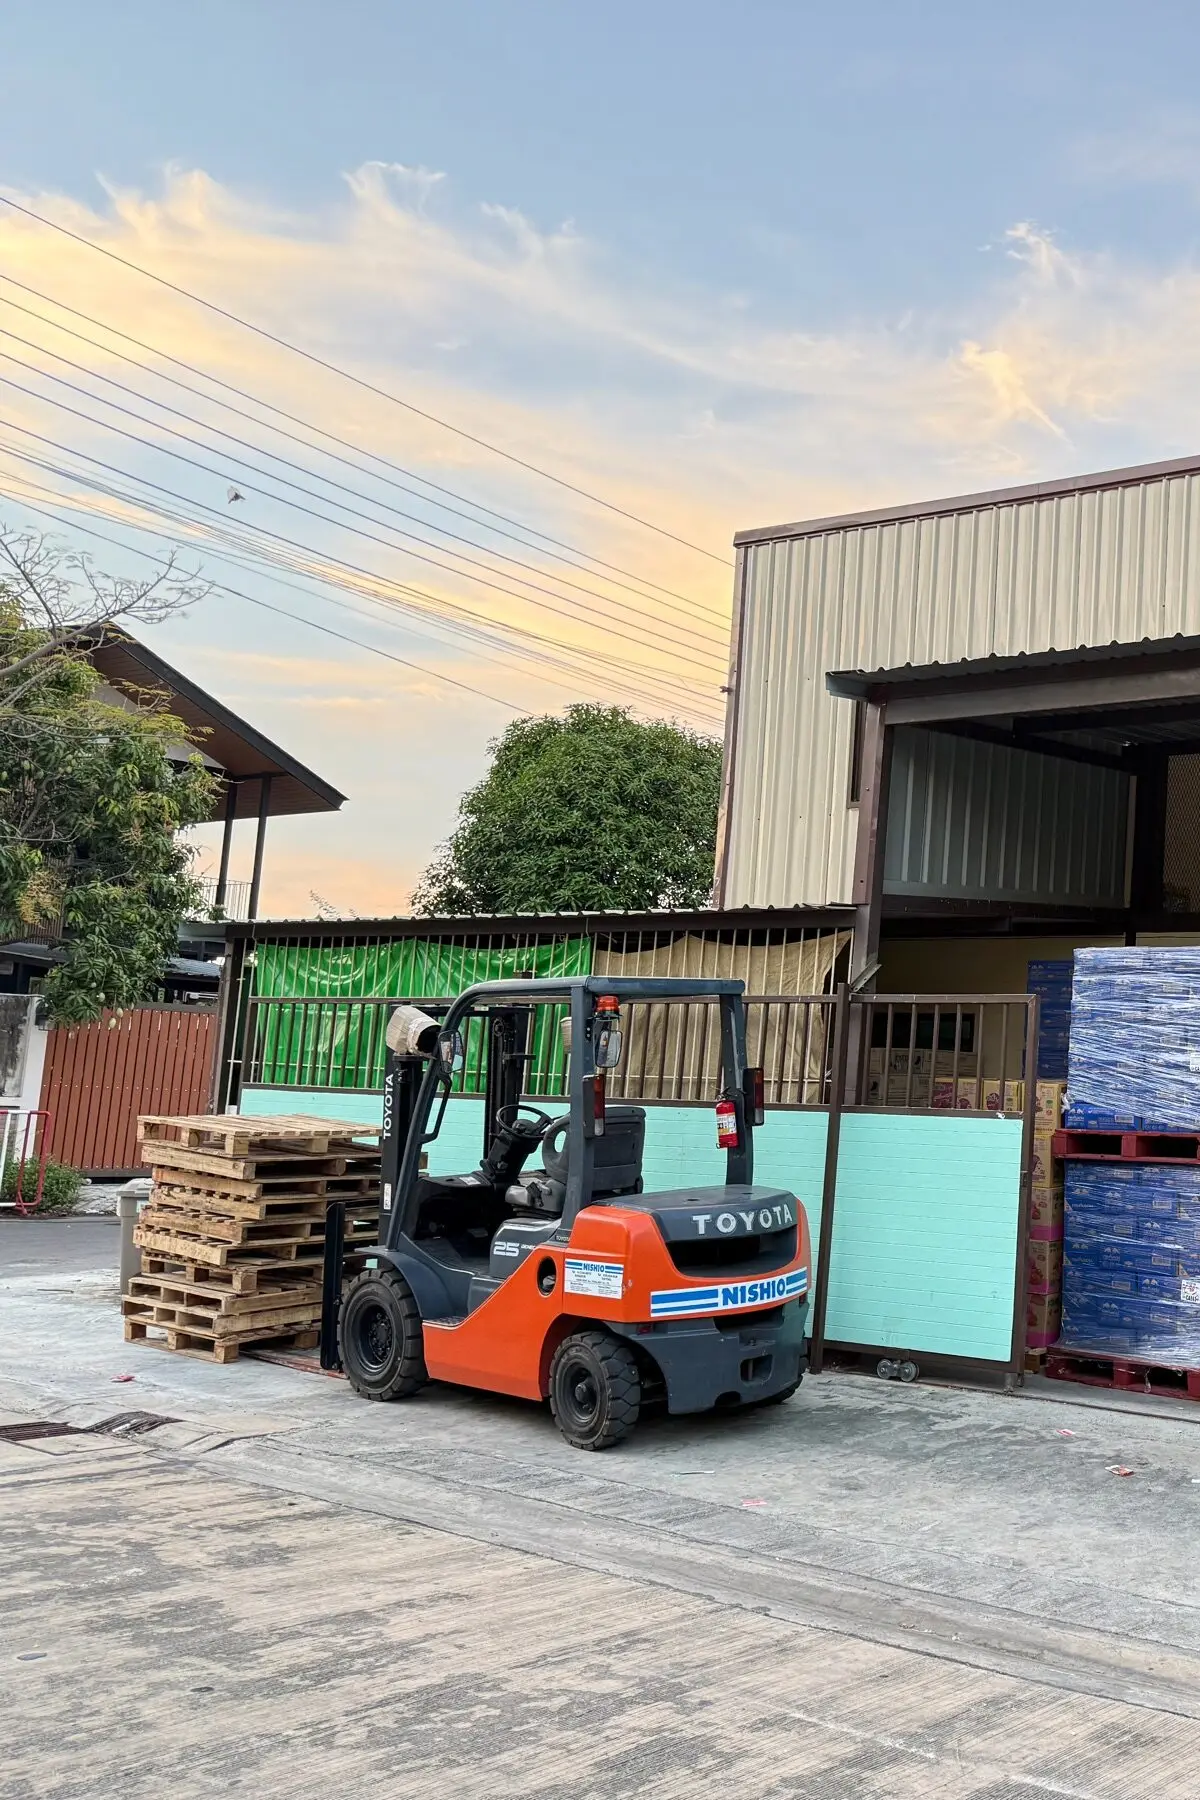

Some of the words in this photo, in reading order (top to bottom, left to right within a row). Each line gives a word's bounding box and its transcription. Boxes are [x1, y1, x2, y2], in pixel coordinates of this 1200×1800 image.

[383, 1073, 394, 1140] TOYOTA
[692, 1203, 793, 1235] TOYOTA
[493, 1241, 520, 1257] 25
[583, 1263, 605, 1273] NISHIO
[722, 1278, 787, 1307] NISHIO
